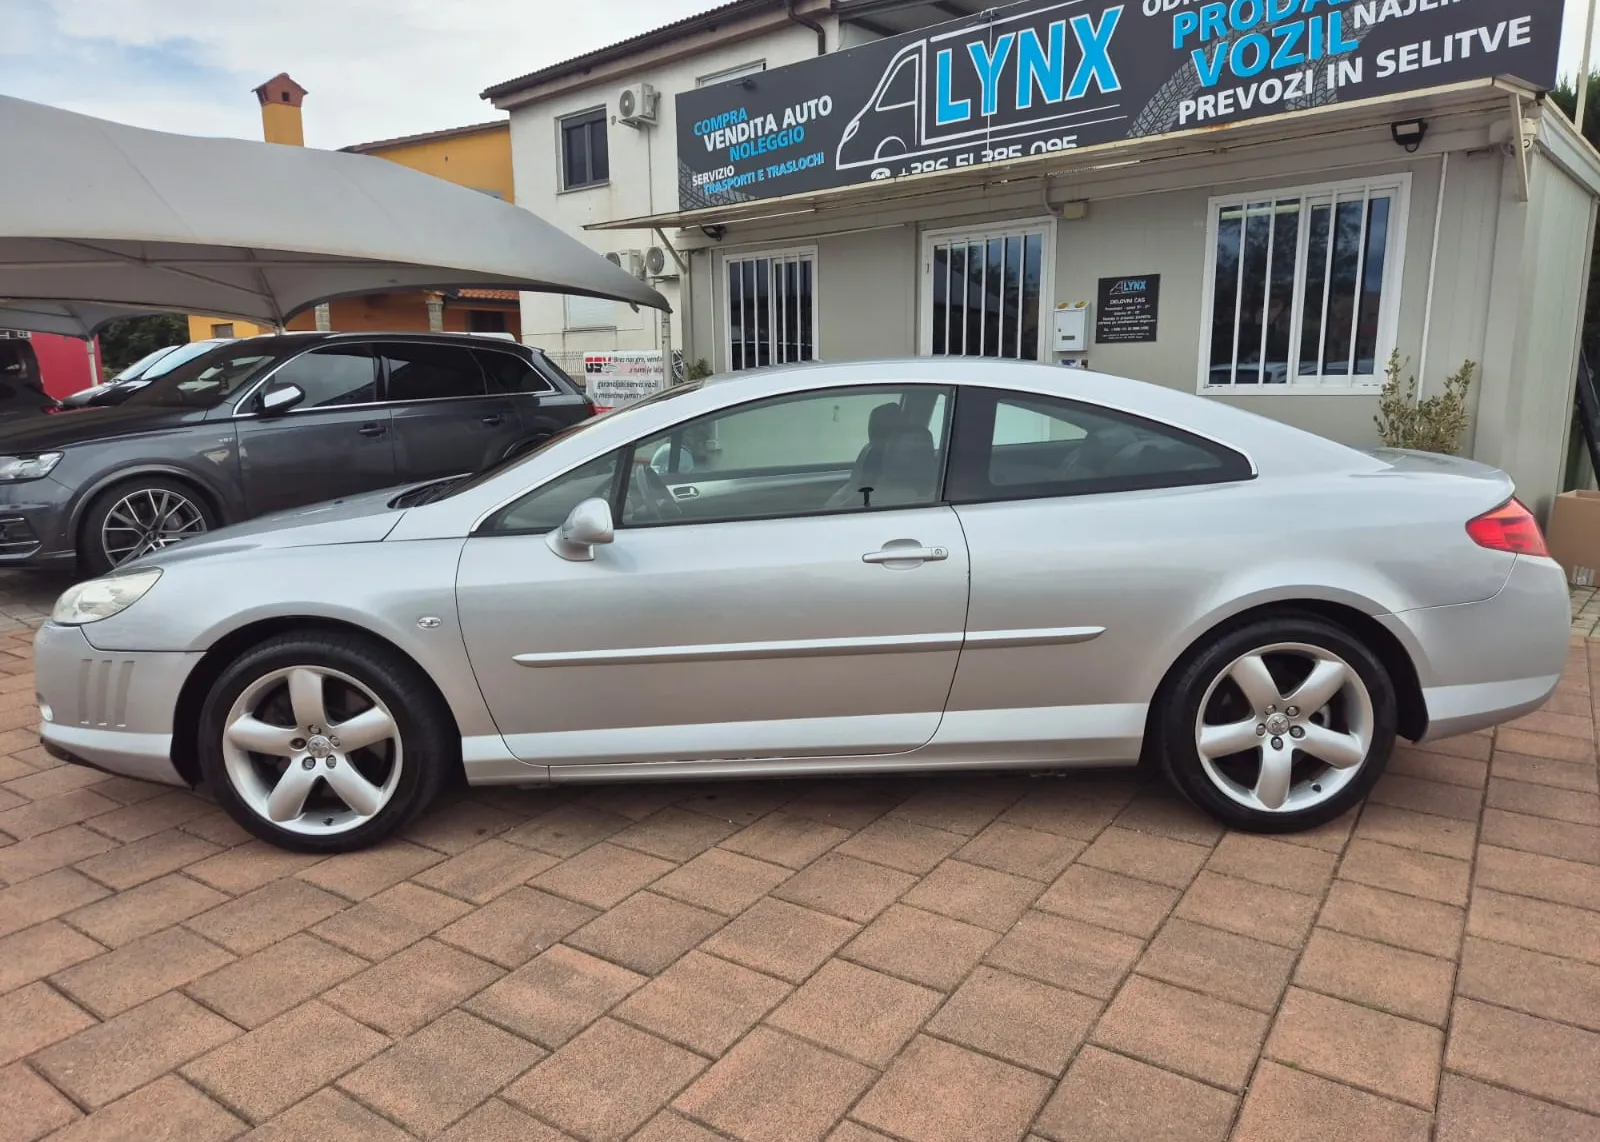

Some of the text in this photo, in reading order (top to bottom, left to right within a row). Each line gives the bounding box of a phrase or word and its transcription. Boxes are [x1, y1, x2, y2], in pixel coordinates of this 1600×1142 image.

[936, 4, 1125, 126] LYNX
[1179, 15, 1532, 124] PREVOZI IN SELITVE
[1191, 10, 1360, 87] VOZIL
[693, 107, 748, 136] COMPRA
[703, 95, 833, 152] VENDITA AUTO
[729, 126, 805, 162] NOLEGGIO
[692, 165, 735, 187] SERVIZIO
[704, 151, 825, 196] TRASPORTI E TRASLOCHI
[1123, 280, 1147, 291] LYNX
